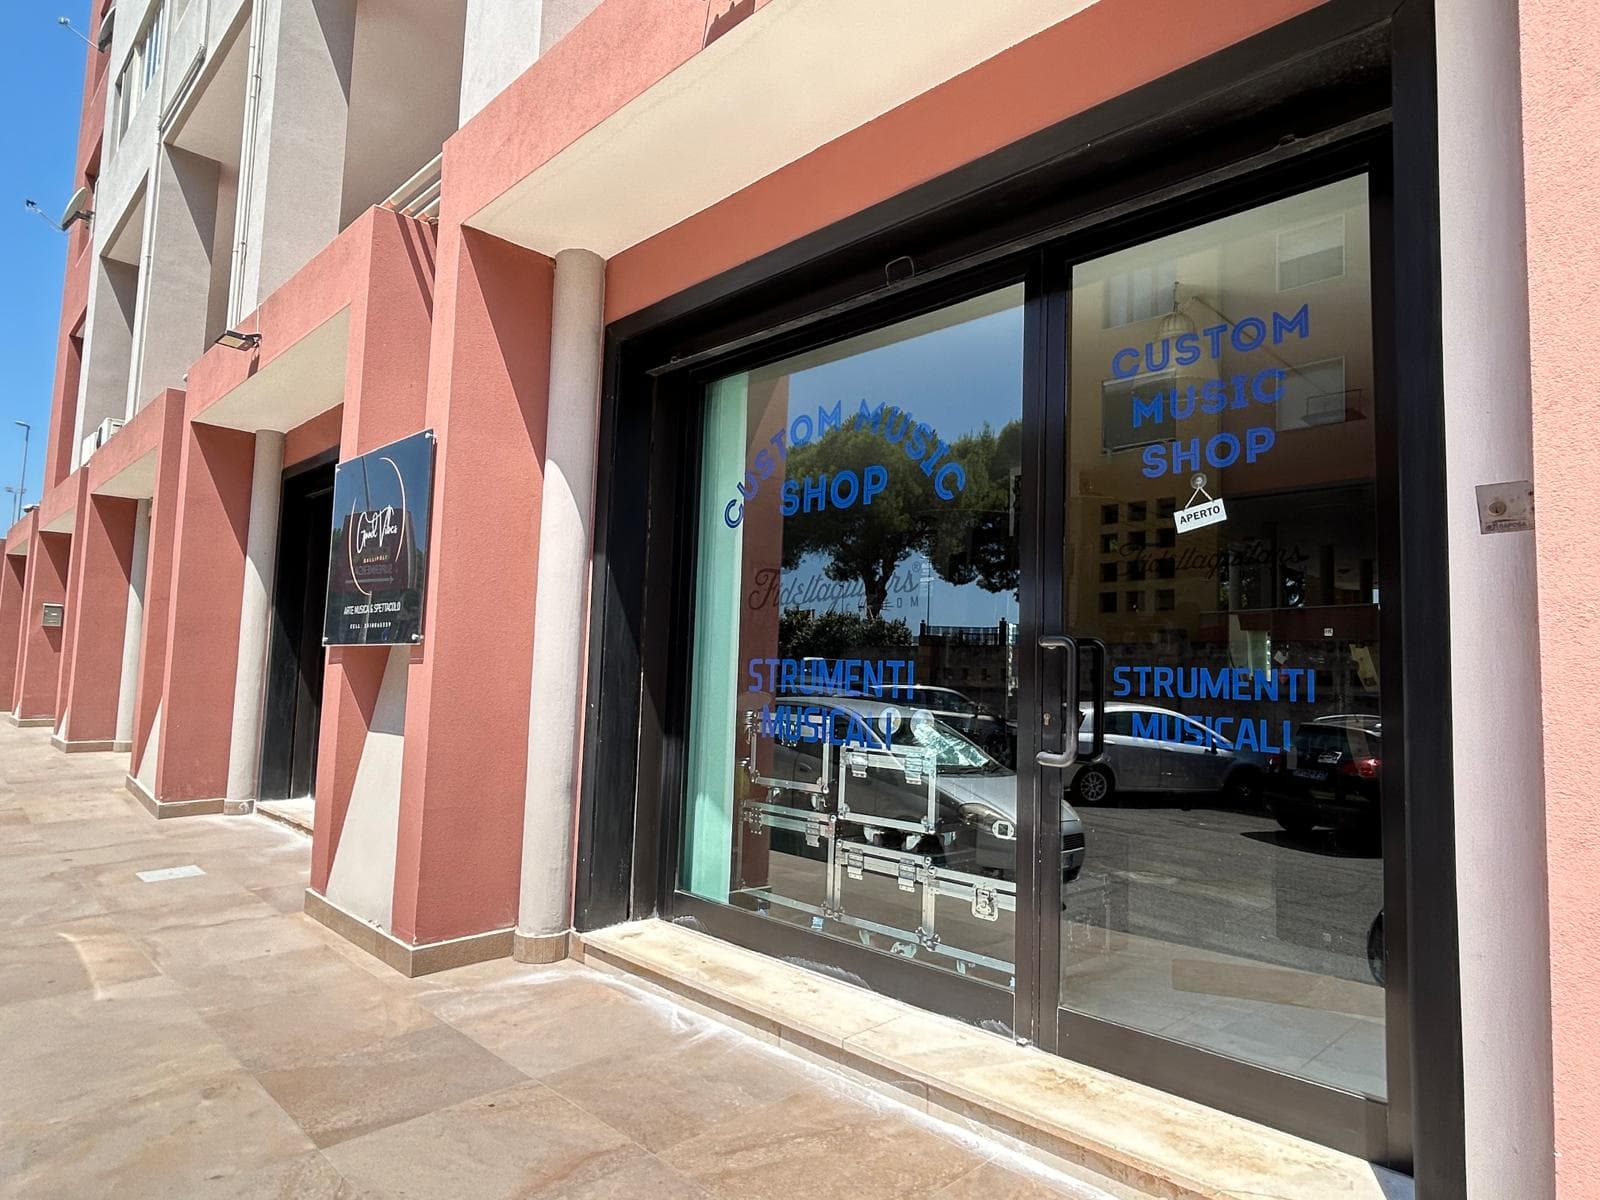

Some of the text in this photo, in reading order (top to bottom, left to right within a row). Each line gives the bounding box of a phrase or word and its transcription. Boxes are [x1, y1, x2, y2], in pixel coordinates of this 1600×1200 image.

[1111, 303, 1310, 380] CUSTOM
[1132, 367, 1288, 429] MUSIC
[724, 398, 966, 529] CUSTOM MUSIC
[1141, 425, 1277, 479] SHOP
[780, 464, 889, 517] SHOP
[1179, 505, 1221, 525] APERTO
[748, 658, 917, 701] STRUMENTI
[1112, 666, 1317, 704] STRUMENTI
[760, 703, 893, 751] MUSICALI
[1131, 712, 1292, 754] MUSICALI
